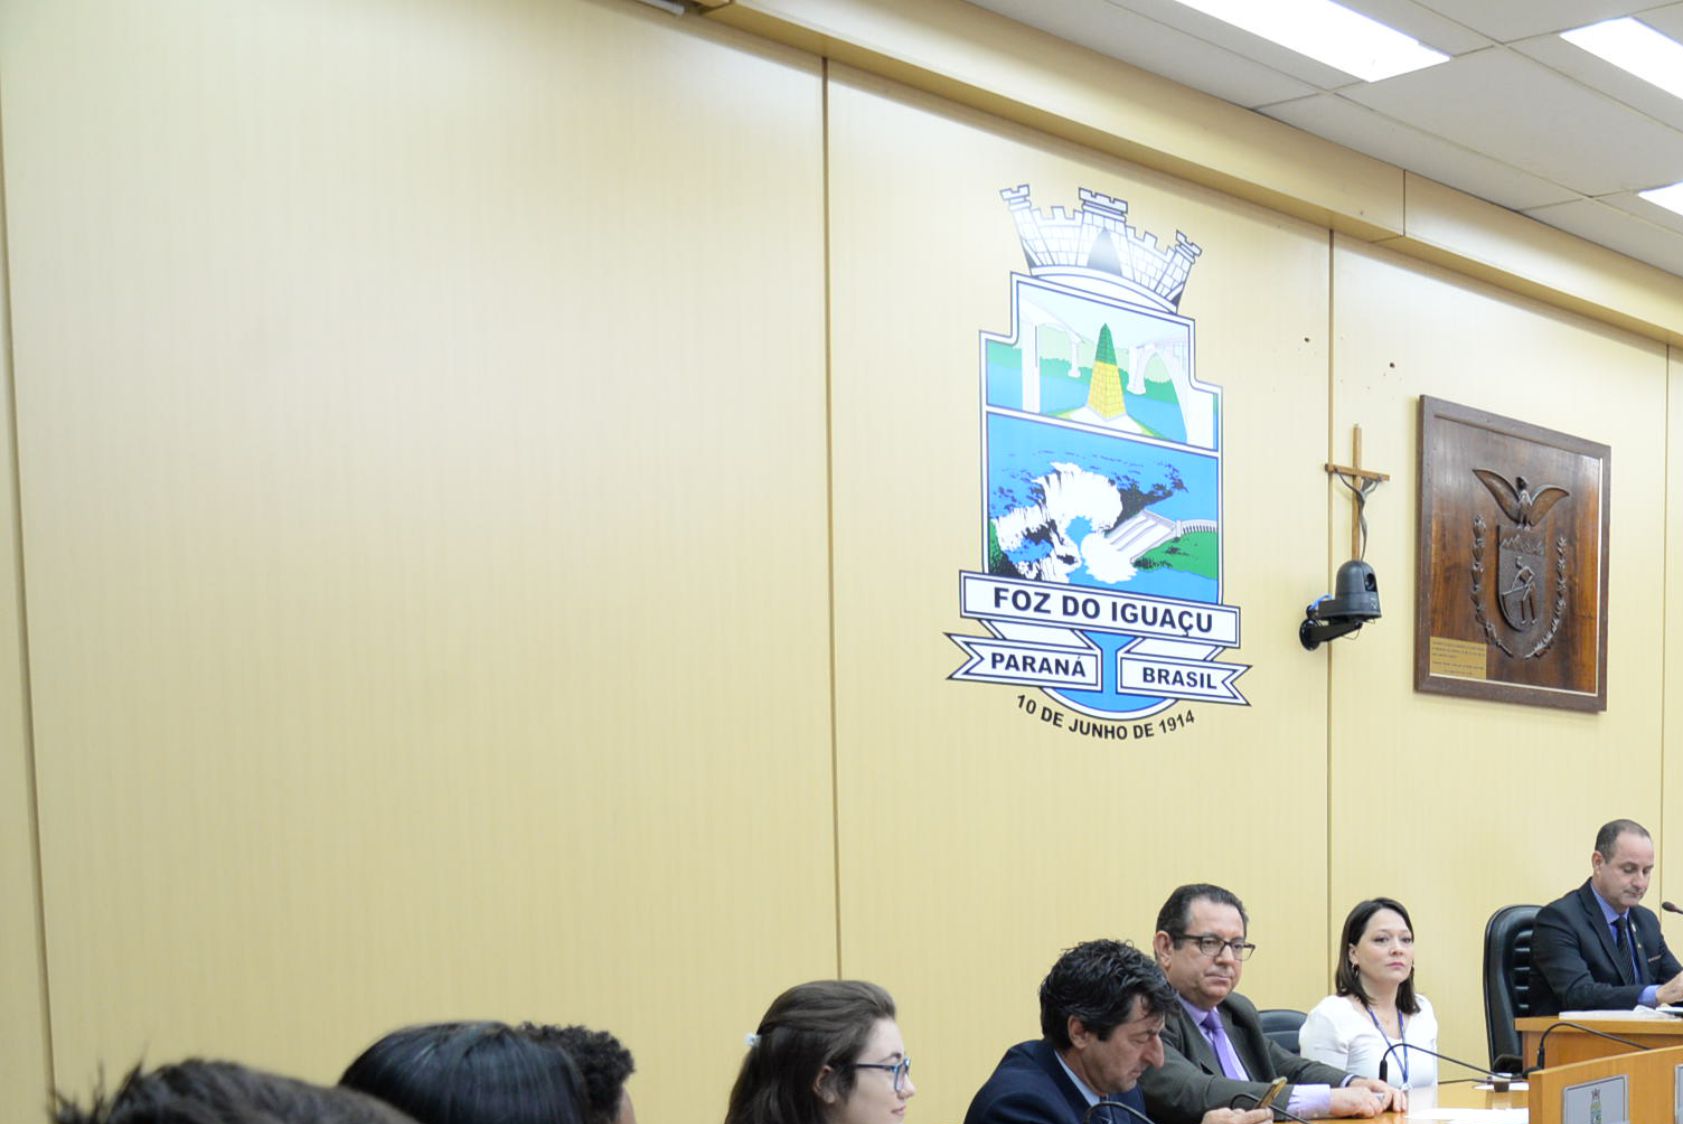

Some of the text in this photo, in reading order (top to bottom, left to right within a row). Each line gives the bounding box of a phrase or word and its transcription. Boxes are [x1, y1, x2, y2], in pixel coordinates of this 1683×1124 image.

[993, 587, 1213, 638] FOZ DO IGUAÇU
[991, 652, 1086, 678] PARANÁ
[1142, 667, 1217, 690] BRASIL
[1016, 694, 1195, 740] 10 DE JUNHO DE 1914
